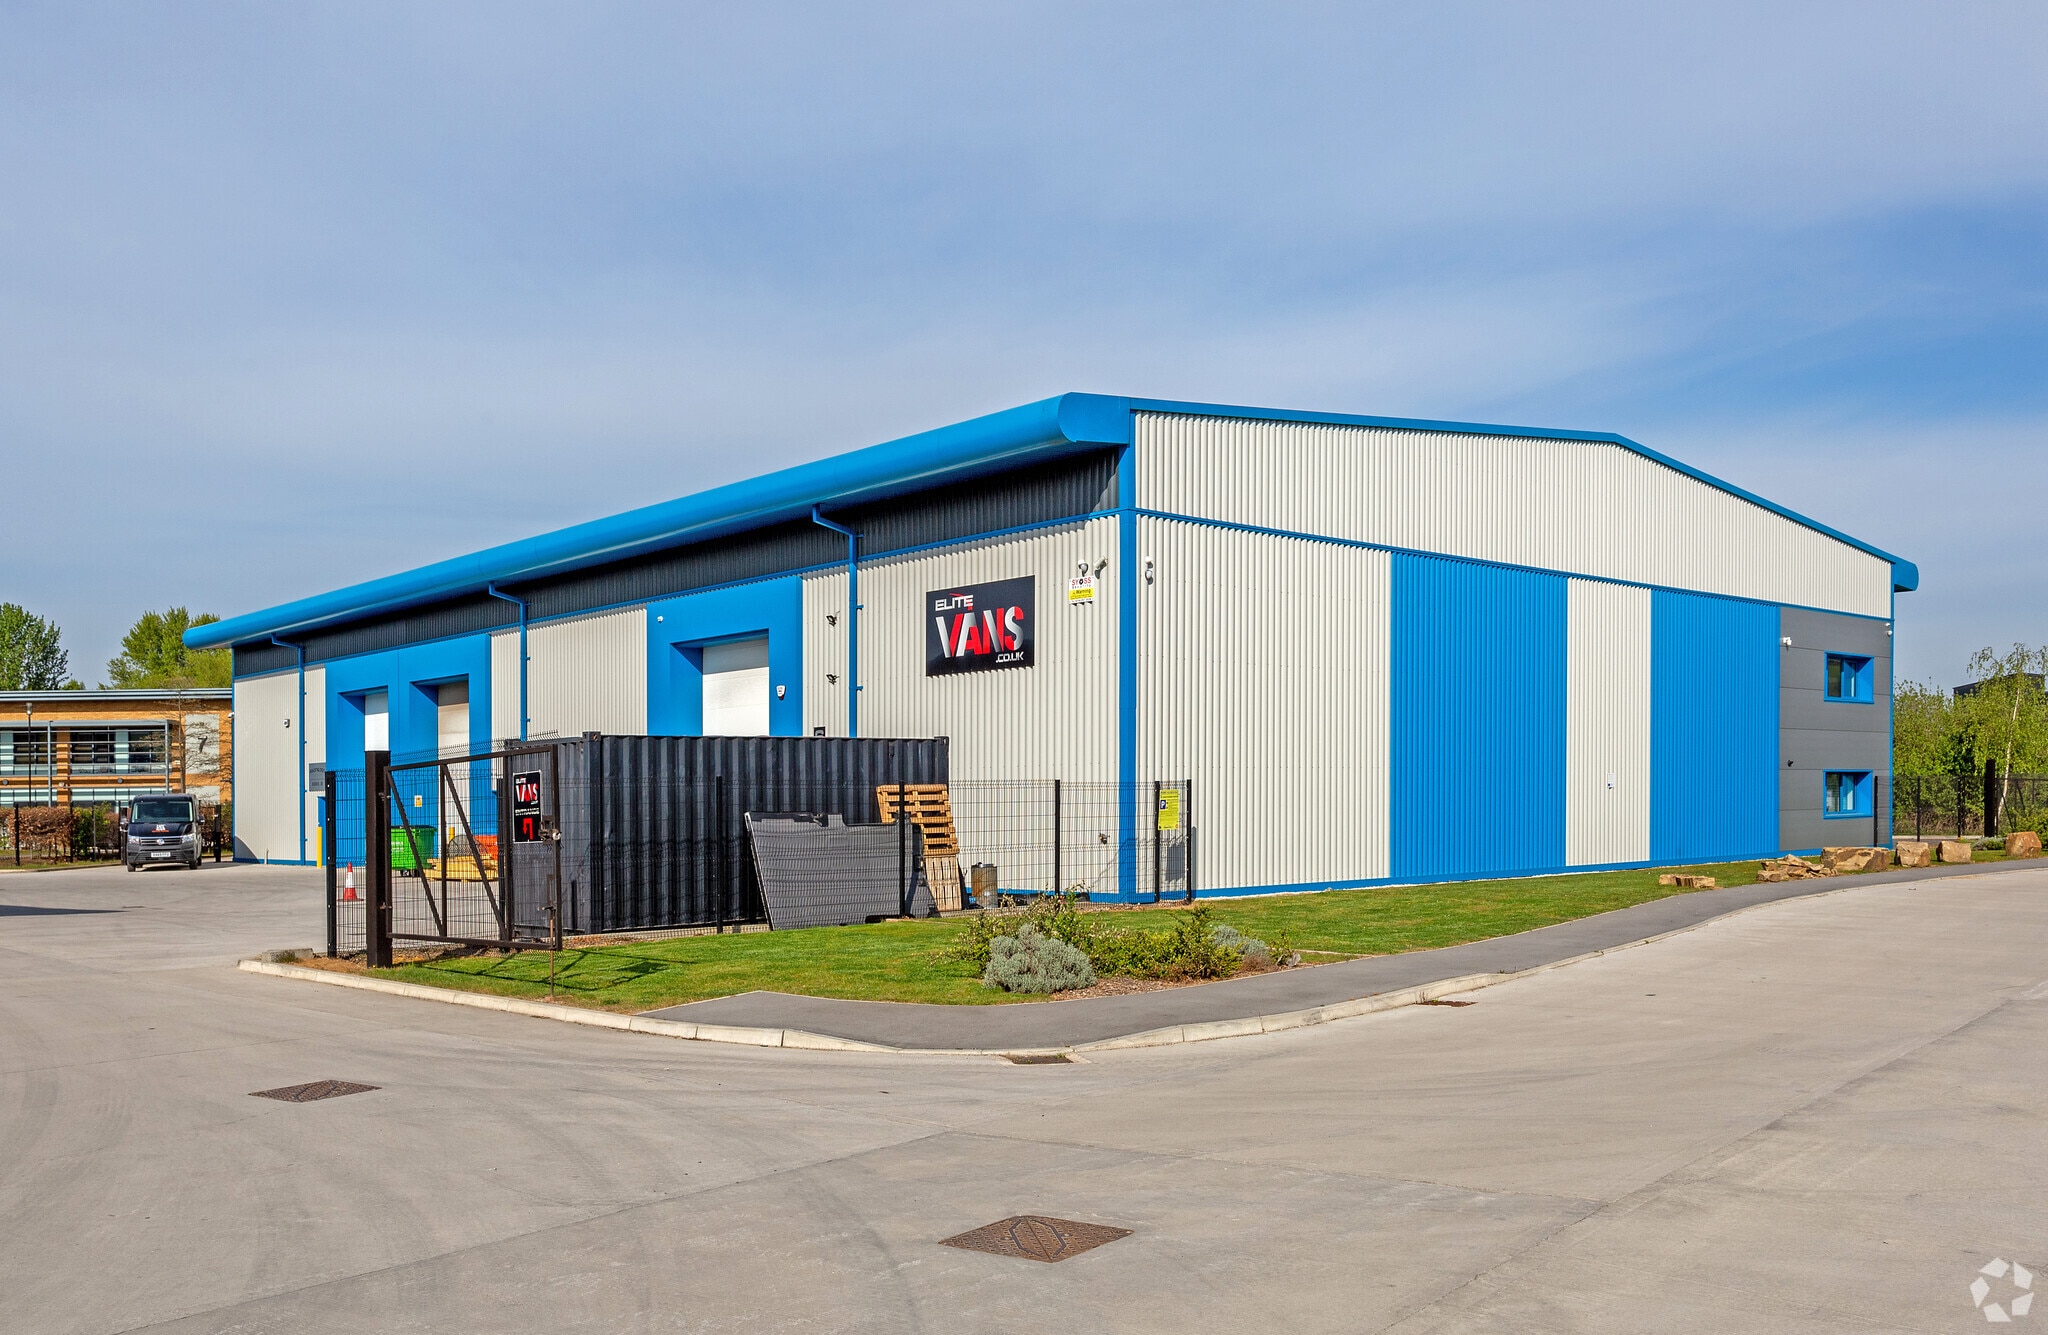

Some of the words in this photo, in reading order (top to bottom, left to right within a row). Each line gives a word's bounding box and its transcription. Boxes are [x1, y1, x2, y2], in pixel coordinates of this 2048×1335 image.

[935, 594, 974, 611] ELITE
[935, 605, 1025, 658] VANS
[995, 651, 1025, 664] .CO.UK
[198, 735, 208, 754] 7
[516, 783, 538, 802] VANS
